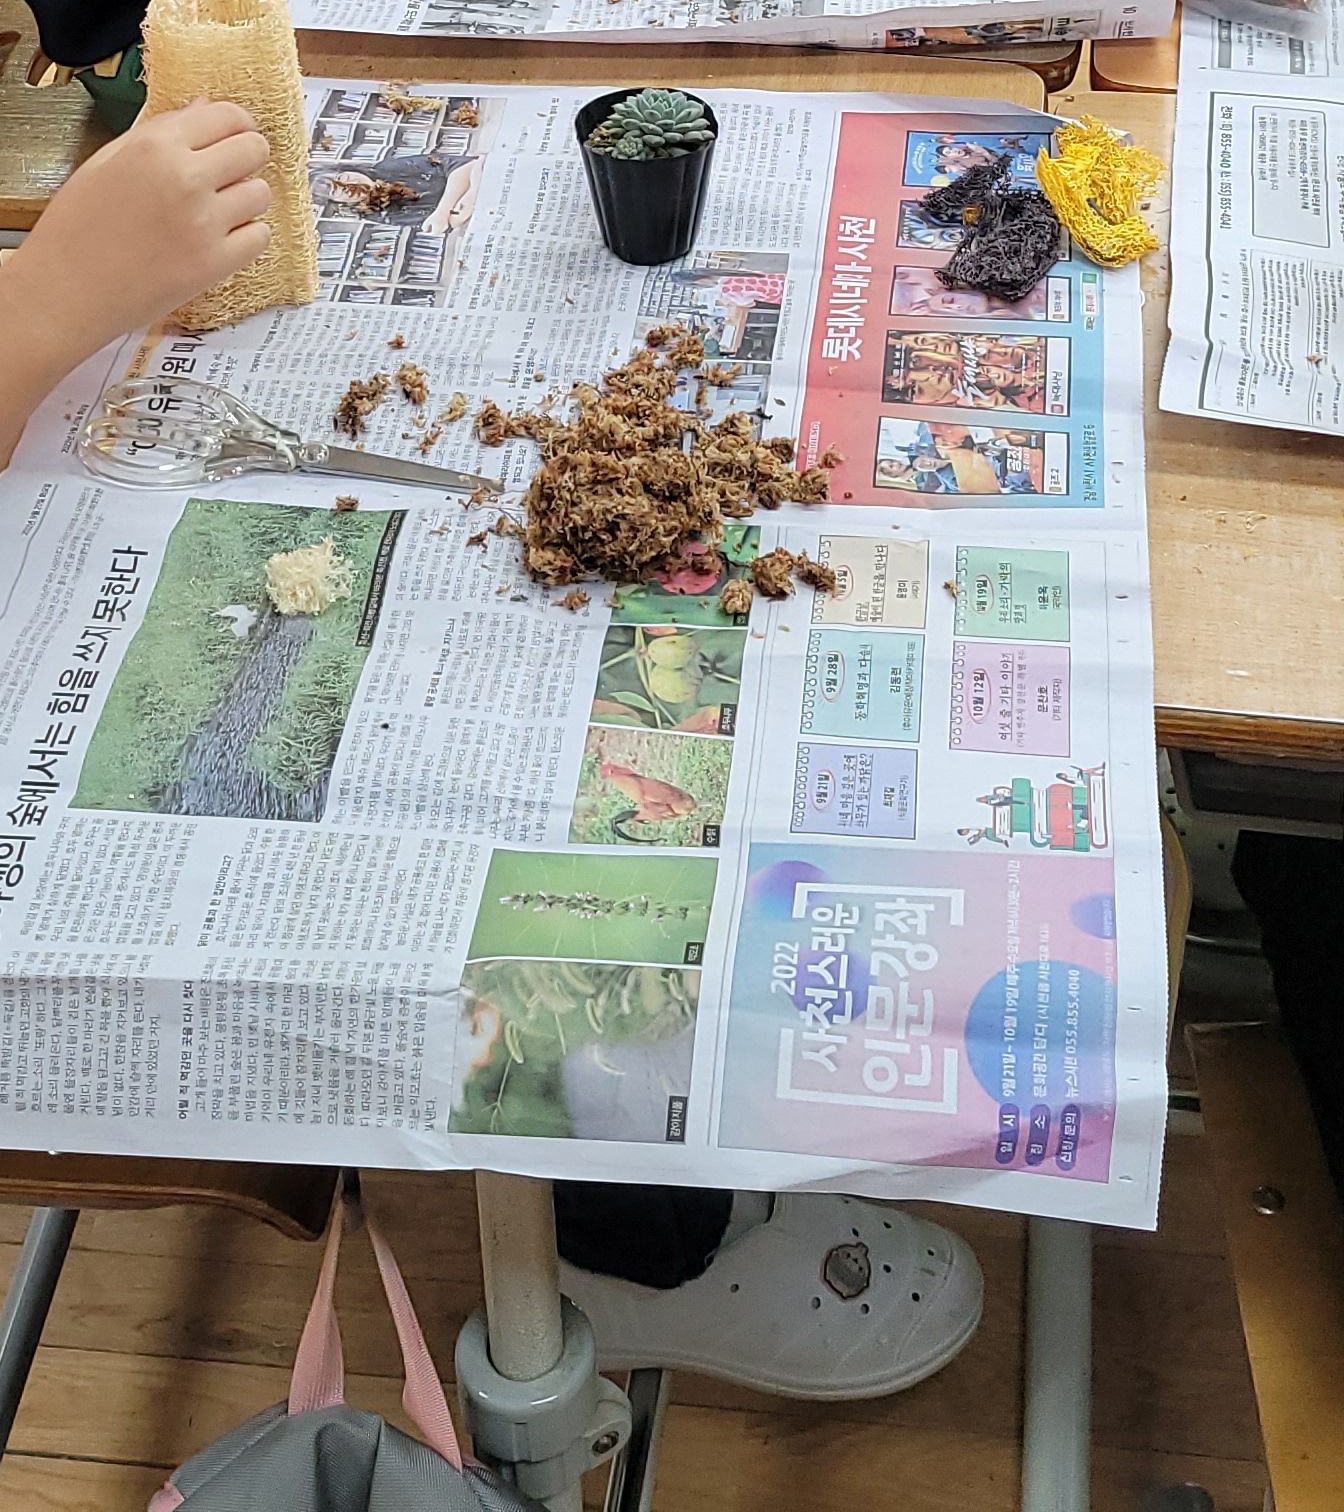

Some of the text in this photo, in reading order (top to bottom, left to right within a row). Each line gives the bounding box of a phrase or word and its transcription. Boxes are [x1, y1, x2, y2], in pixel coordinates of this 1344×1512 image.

[1220, 134, 1232, 168] 855-4040
[1220, 198, 1232, 229] 855-4041
[822, 215, 876, 361] 롯데시네마 사천
[97, 546, 149, 622] 못한다
[976, 580, 988, 599] 19일
[73, 625, 122, 660] 쓰지
[826, 654, 839, 692] 9월 28일
[45, 670, 97, 716] 힘을
[973, 672, 986, 716] 10월 12일
[1000, 684, 1012, 704] 기타
[6, 721, 67, 827] 숲에서는
[816, 774, 830, 804] 9월 21일
[770, 942, 799, 995] 2022
[801, 904, 859, 1072] 사천스러운
[862, 898, 940, 1094] 인문강좌
[1005, 988, 1019, 1012] 19일
[182, 1003, 194, 1022] 다시
[1004, 1016, 1018, 1041] 10월
[1065, 970, 1080, 1053] 055.855.4040
[182, 1026, 194, 1047] 곳을
[1002, 1079, 1017, 1096] 9월
[1033, 1054, 1048, 1098] 문화공간
[670, 1100, 685, 1137] 강아지풀
